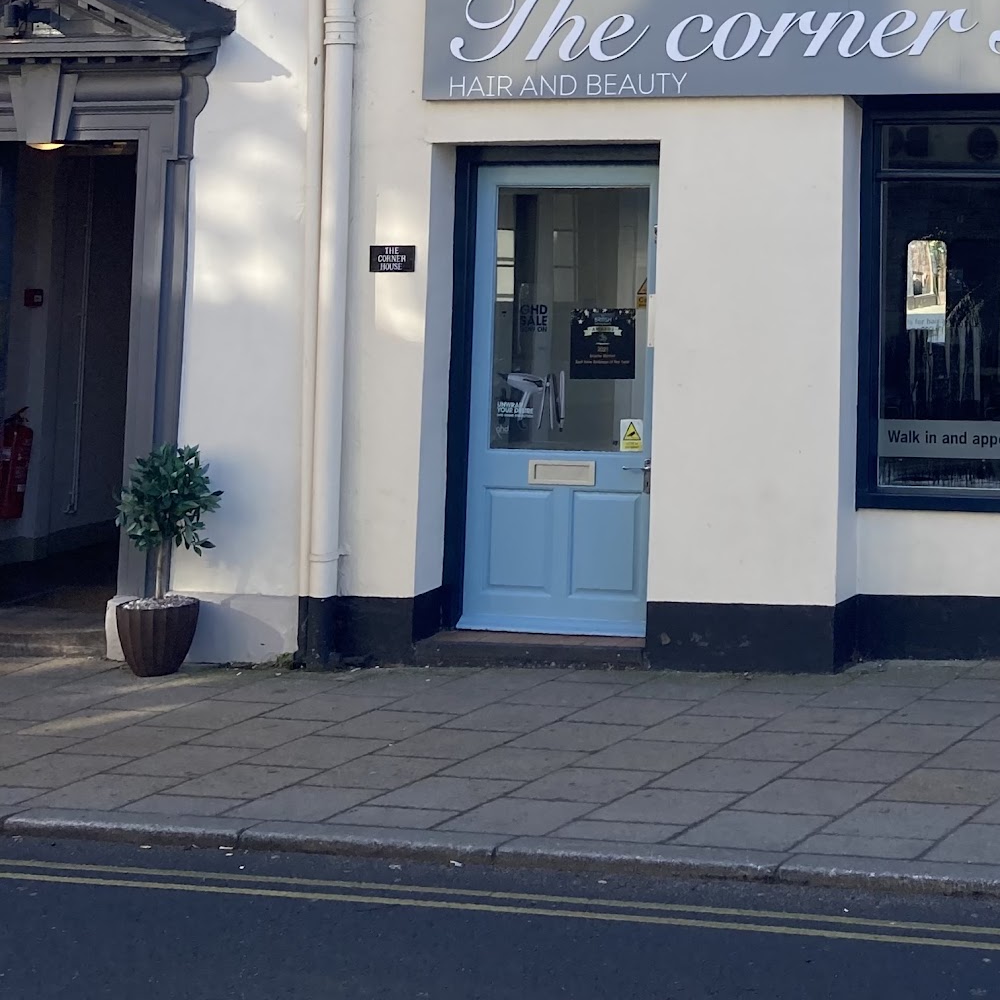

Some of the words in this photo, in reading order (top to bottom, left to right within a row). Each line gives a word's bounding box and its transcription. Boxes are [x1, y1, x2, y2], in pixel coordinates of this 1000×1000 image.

[665, 9, 979, 63] corner
[449, 75, 513, 97] HAIR
[519, 73, 578, 96] AND
[586, 72, 688, 96] BEAUTY
[385, 247, 400, 255] THE
[520, 315, 548, 326] SALE
[887, 430, 920, 444] Walk
[925, 431, 937, 444] in
[942, 431, 968, 445] and
